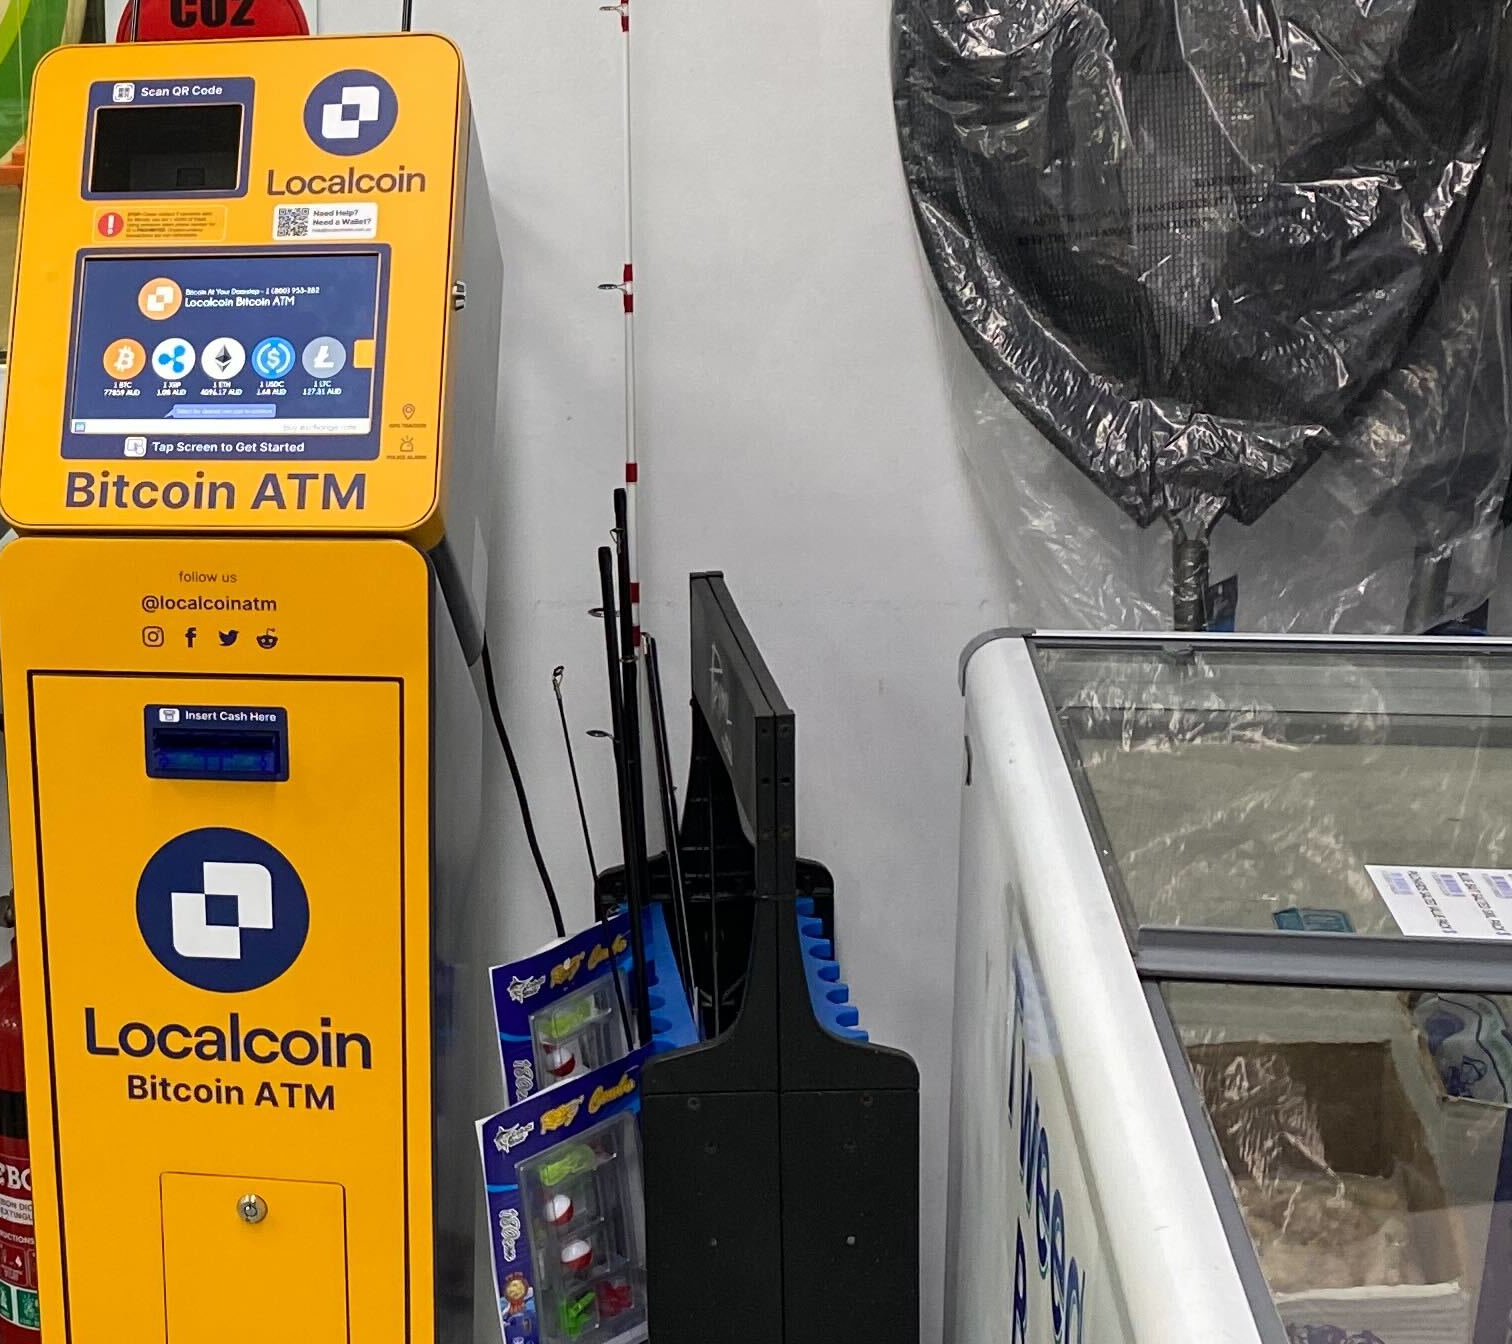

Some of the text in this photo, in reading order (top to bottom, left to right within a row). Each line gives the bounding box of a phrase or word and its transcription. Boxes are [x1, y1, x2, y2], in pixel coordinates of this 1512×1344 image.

[140, 85, 223, 97] Scan QR Code
[266, 165, 426, 196] Localcoin
[335, 209, 359, 217] Help?
[342, 218, 372, 226] Wallet?
[185, 296, 295, 307] Localcoin Bitcoin ATM
[228, 388, 243, 396] AUD
[152, 441, 305, 454] Tap Screen to Get Started
[65, 470, 366, 510] Bitcoin ATM
[178, 571, 237, 583] follow us
[142, 595, 277, 613] @localcoinatm
[185, 710, 277, 722] Insert Cash Here
[85, 1007, 372, 1070] Localcoin
[127, 1074, 335, 1111] Bitcoin ATM
